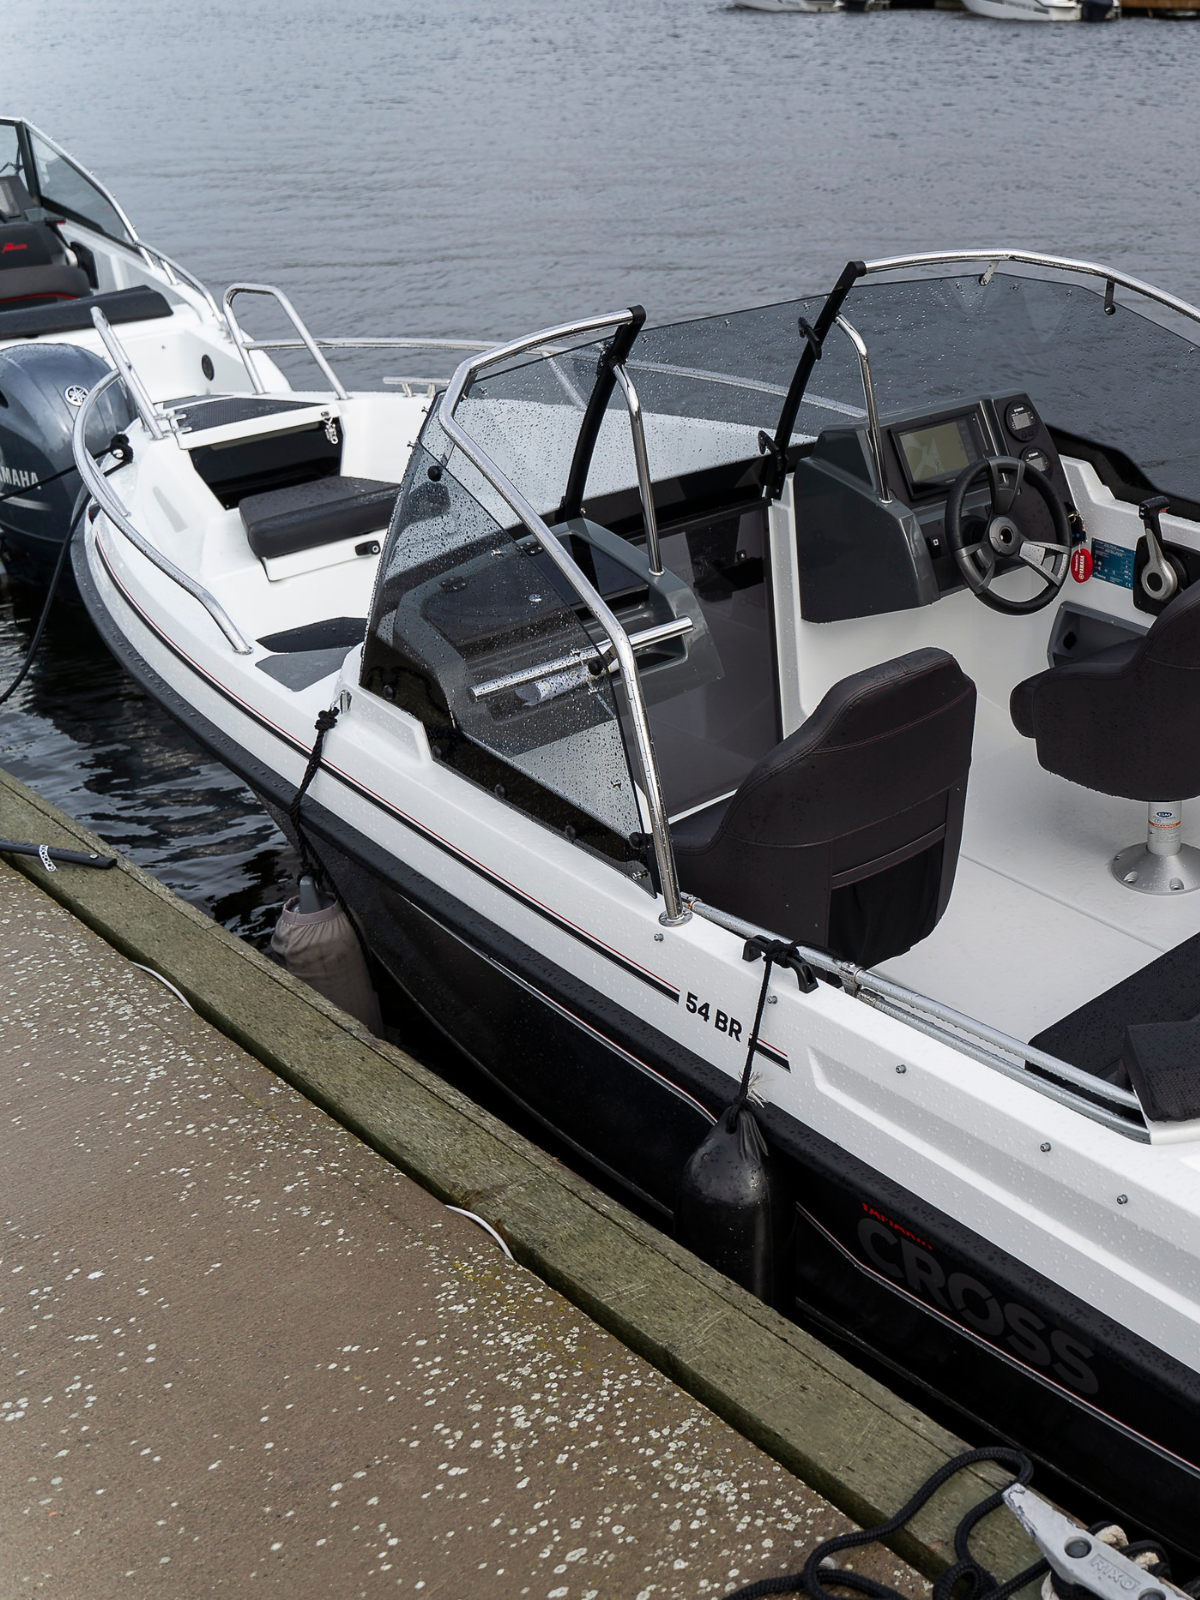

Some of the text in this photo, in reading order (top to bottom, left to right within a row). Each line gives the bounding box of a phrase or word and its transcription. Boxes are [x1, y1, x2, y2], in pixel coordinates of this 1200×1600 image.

[0, 466, 42, 490] MAHA
[685, 991, 742, 1043] 54 BR
[857, 1217, 1099, 1395] CROSS
[1091, 1559, 1136, 1590] RIXO
